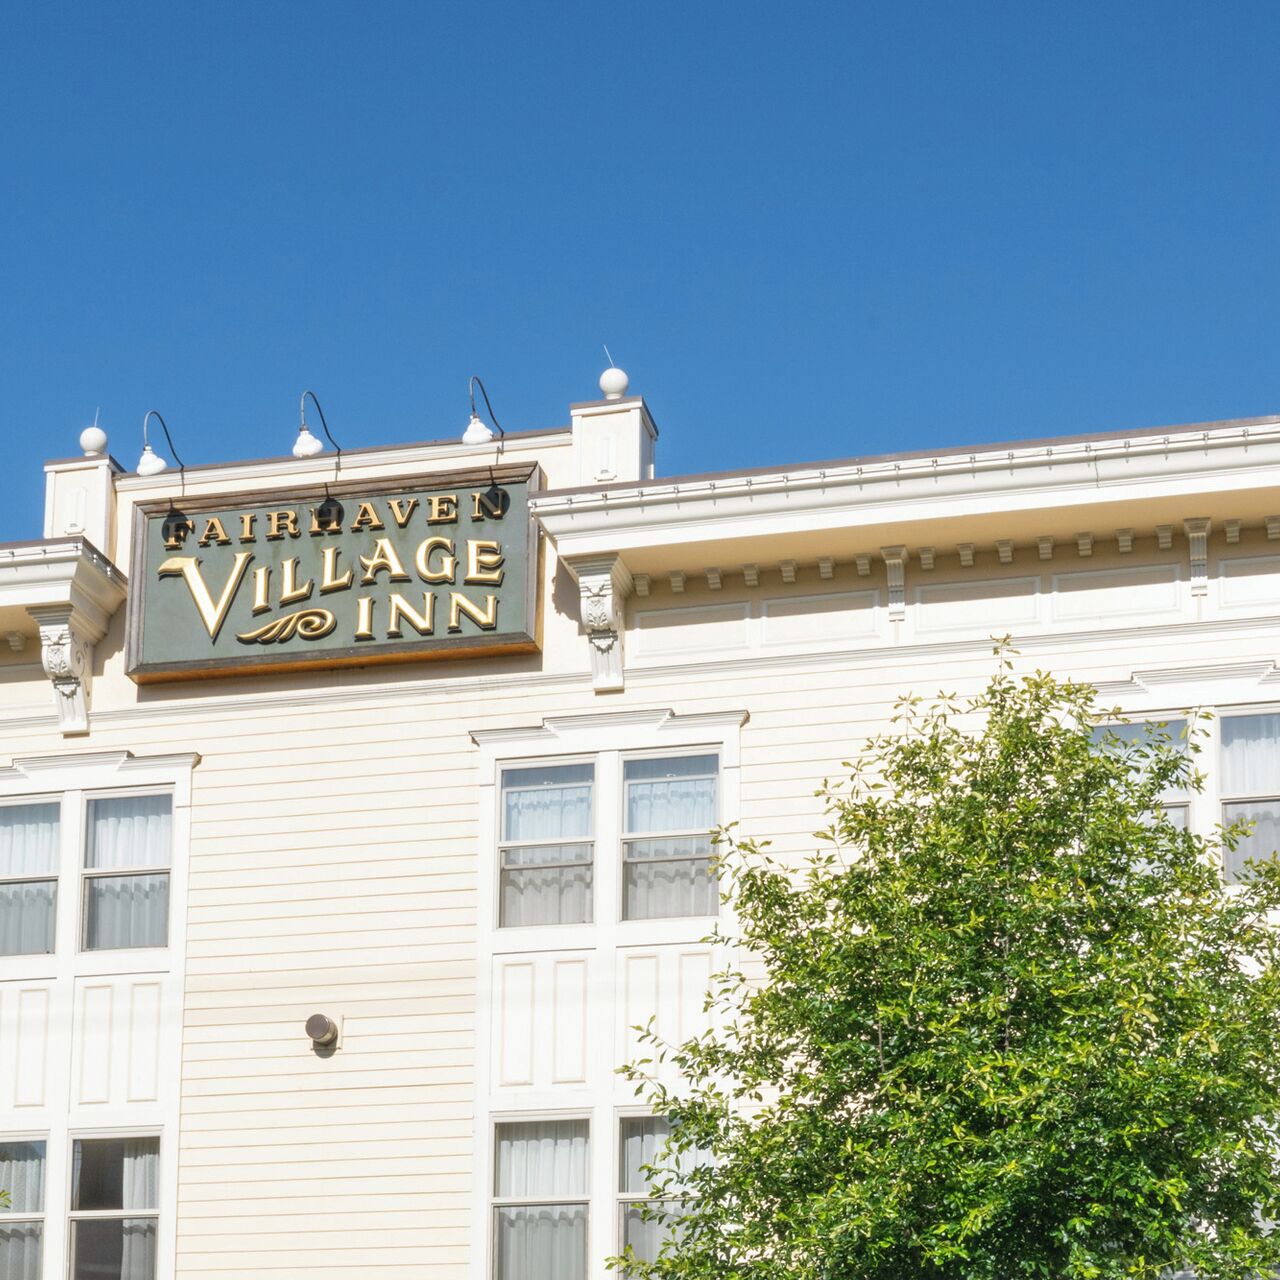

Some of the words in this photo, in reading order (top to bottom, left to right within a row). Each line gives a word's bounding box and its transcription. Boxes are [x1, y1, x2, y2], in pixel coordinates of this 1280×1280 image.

[163, 491, 507, 551] FAIRHAVEN
[157, 536, 505, 644] VILLAGE
[354, 591, 499, 642] INN
